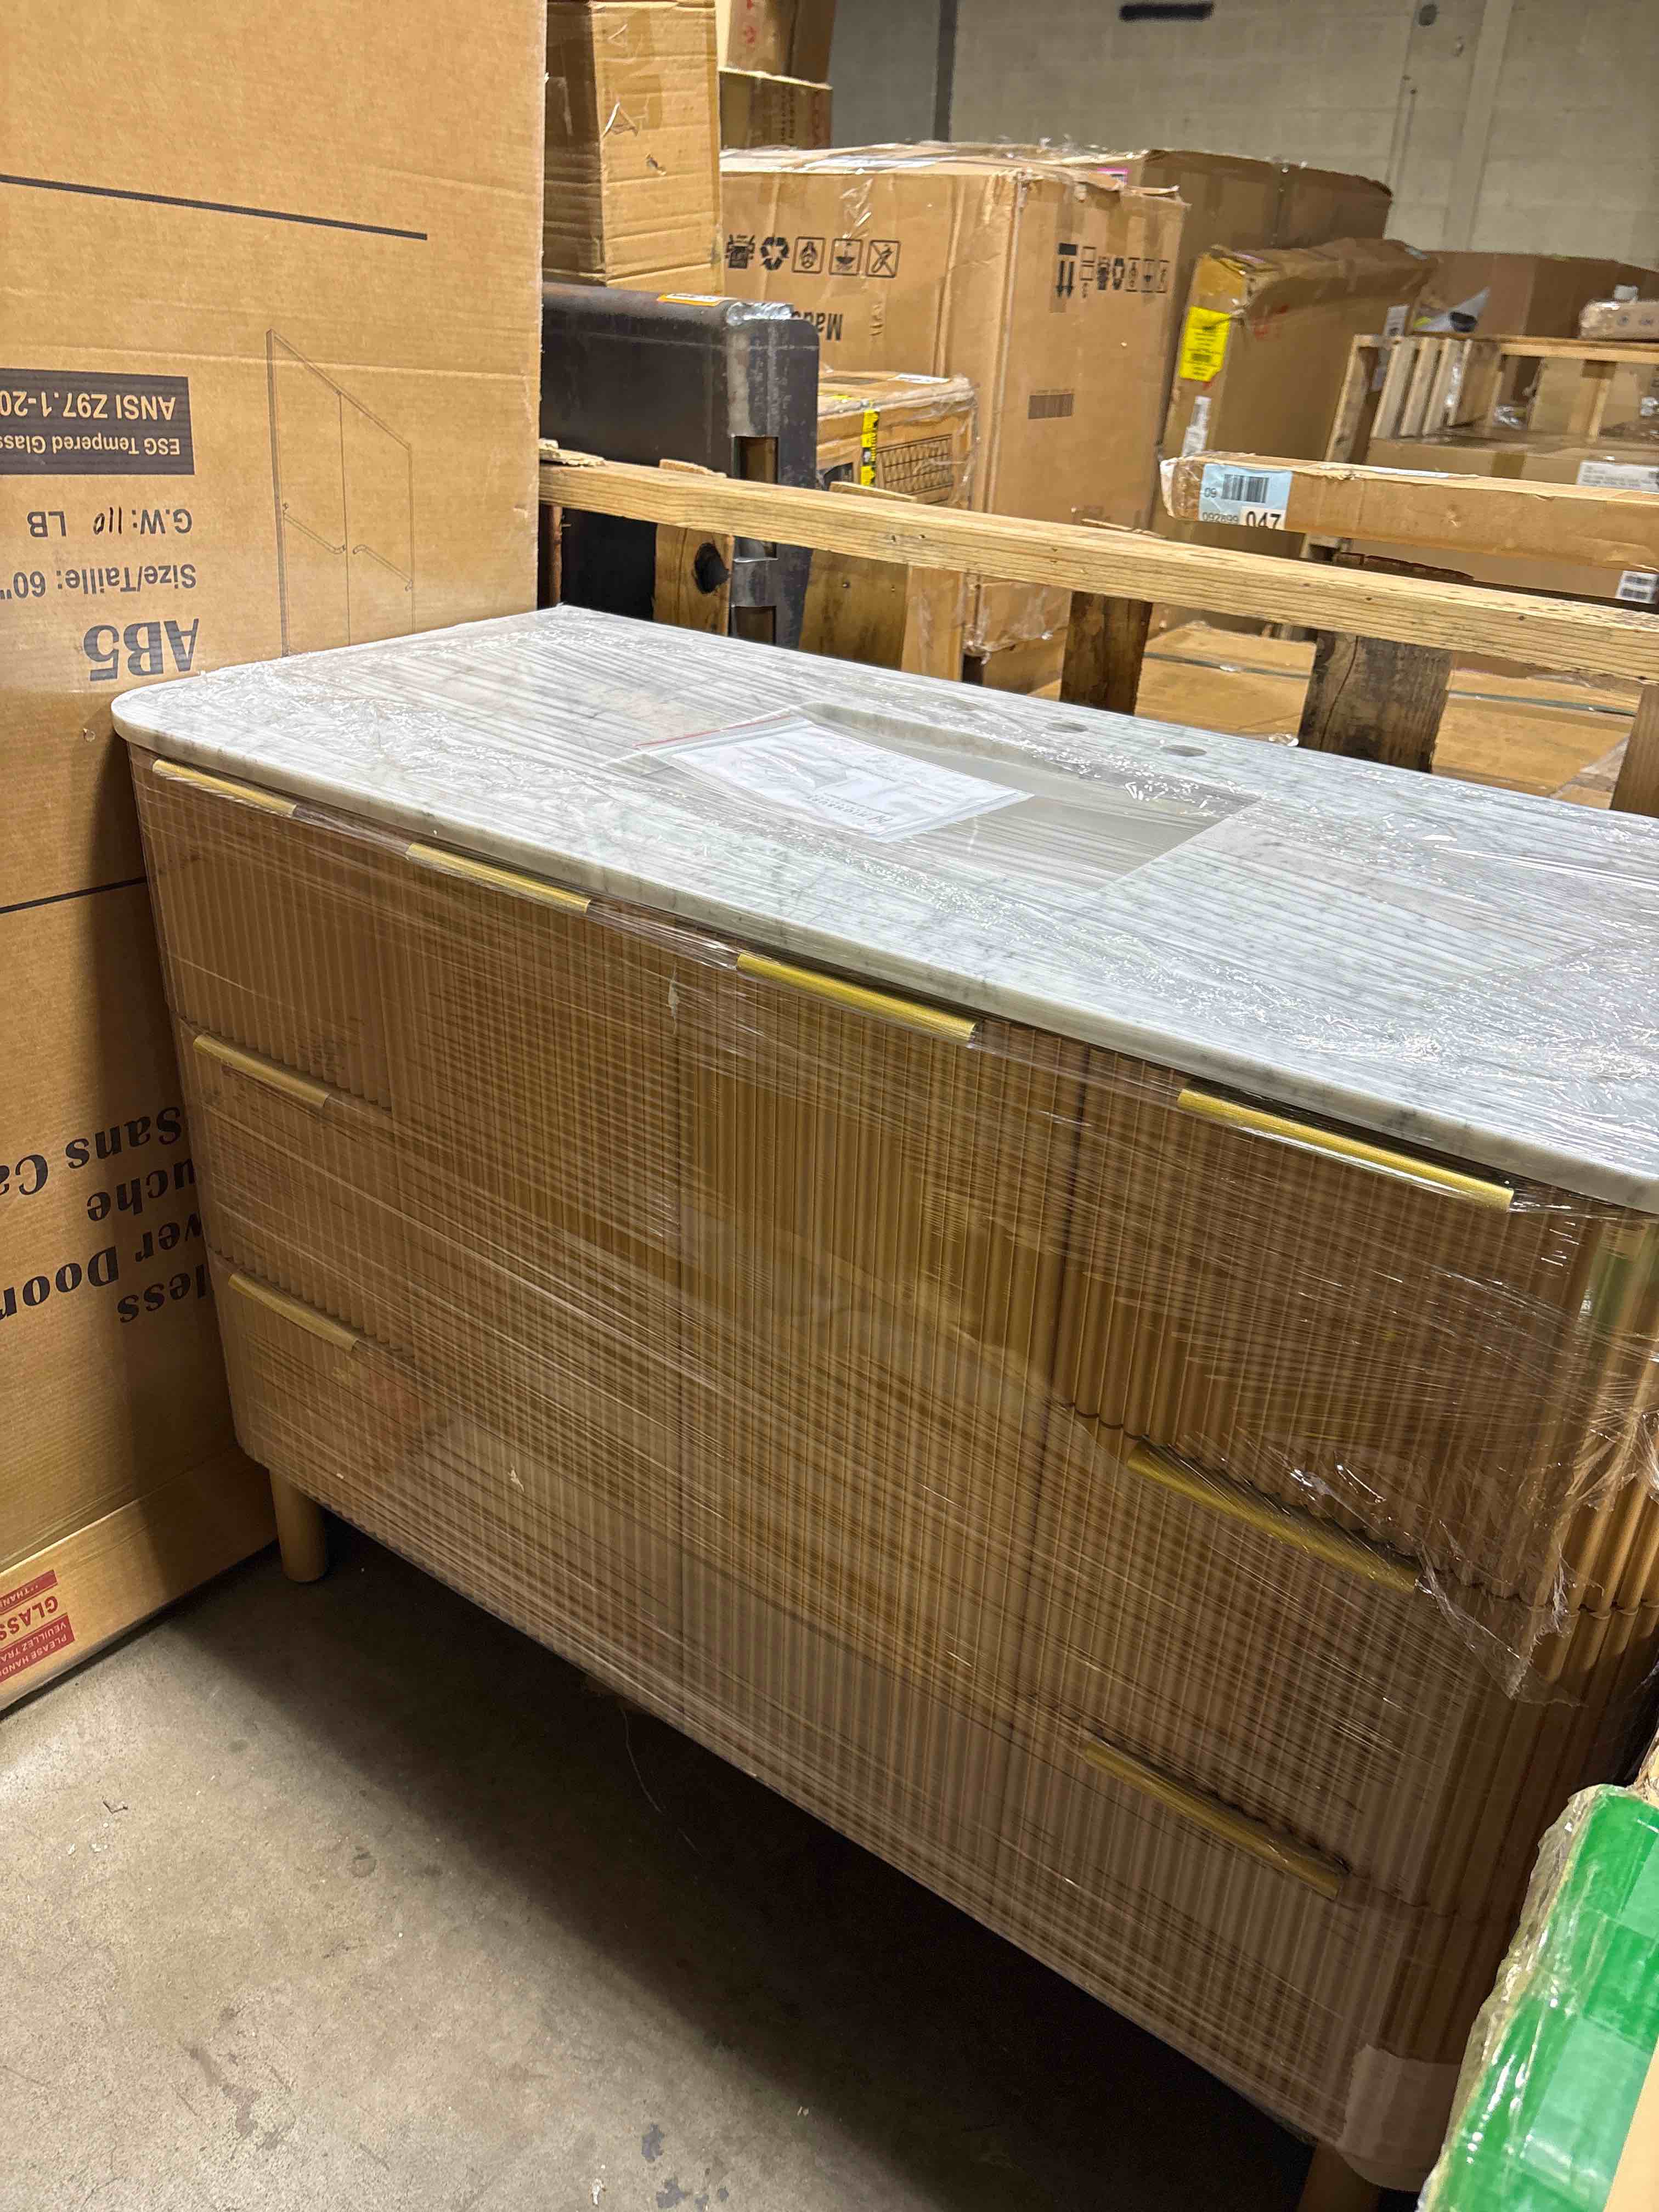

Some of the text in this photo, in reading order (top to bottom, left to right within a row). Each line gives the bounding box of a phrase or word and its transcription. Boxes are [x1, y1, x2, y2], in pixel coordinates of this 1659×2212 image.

[116, 394, 176, 420] ANSI
[52, 432, 139, 455] Tempered
[144, 437, 180, 455] ESG
[27, 510, 66, 538] LB
[132, 509, 193, 535] G.W:
[1246, 511, 1281, 529] 047
[56, 564, 196, 595] Size/Taille:
[83, 618, 199, 681] AB5
[65, 1107, 181, 1170] Sans
[21, 1622, 66, 1651] VEUILLEZ
[31, 1633, 67, 1660] PLEASE
